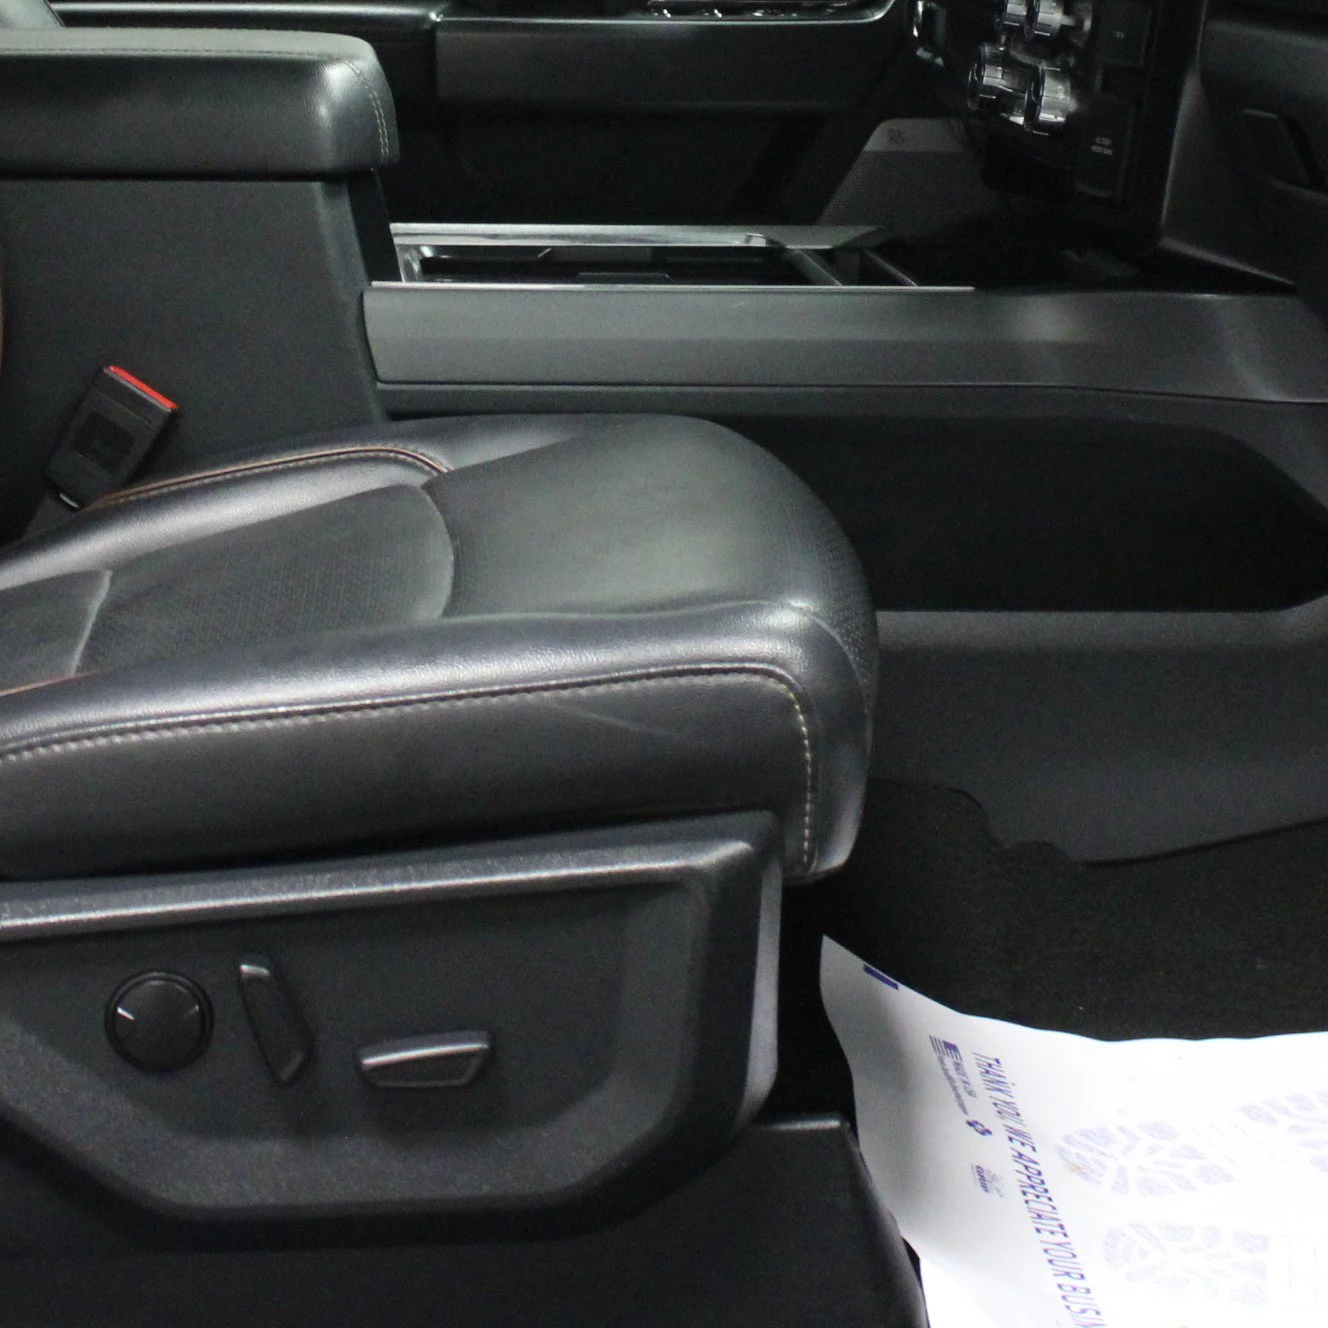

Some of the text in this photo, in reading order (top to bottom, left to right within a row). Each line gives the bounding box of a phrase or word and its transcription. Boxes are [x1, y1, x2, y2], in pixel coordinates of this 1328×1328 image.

[971, 1051, 1015, 1100] THANK
[1001, 1123, 1037, 1154] WE
[1009, 1145, 1070, 1239] APPRECIATE
[1039, 1239, 1087, 1282] YOUR
